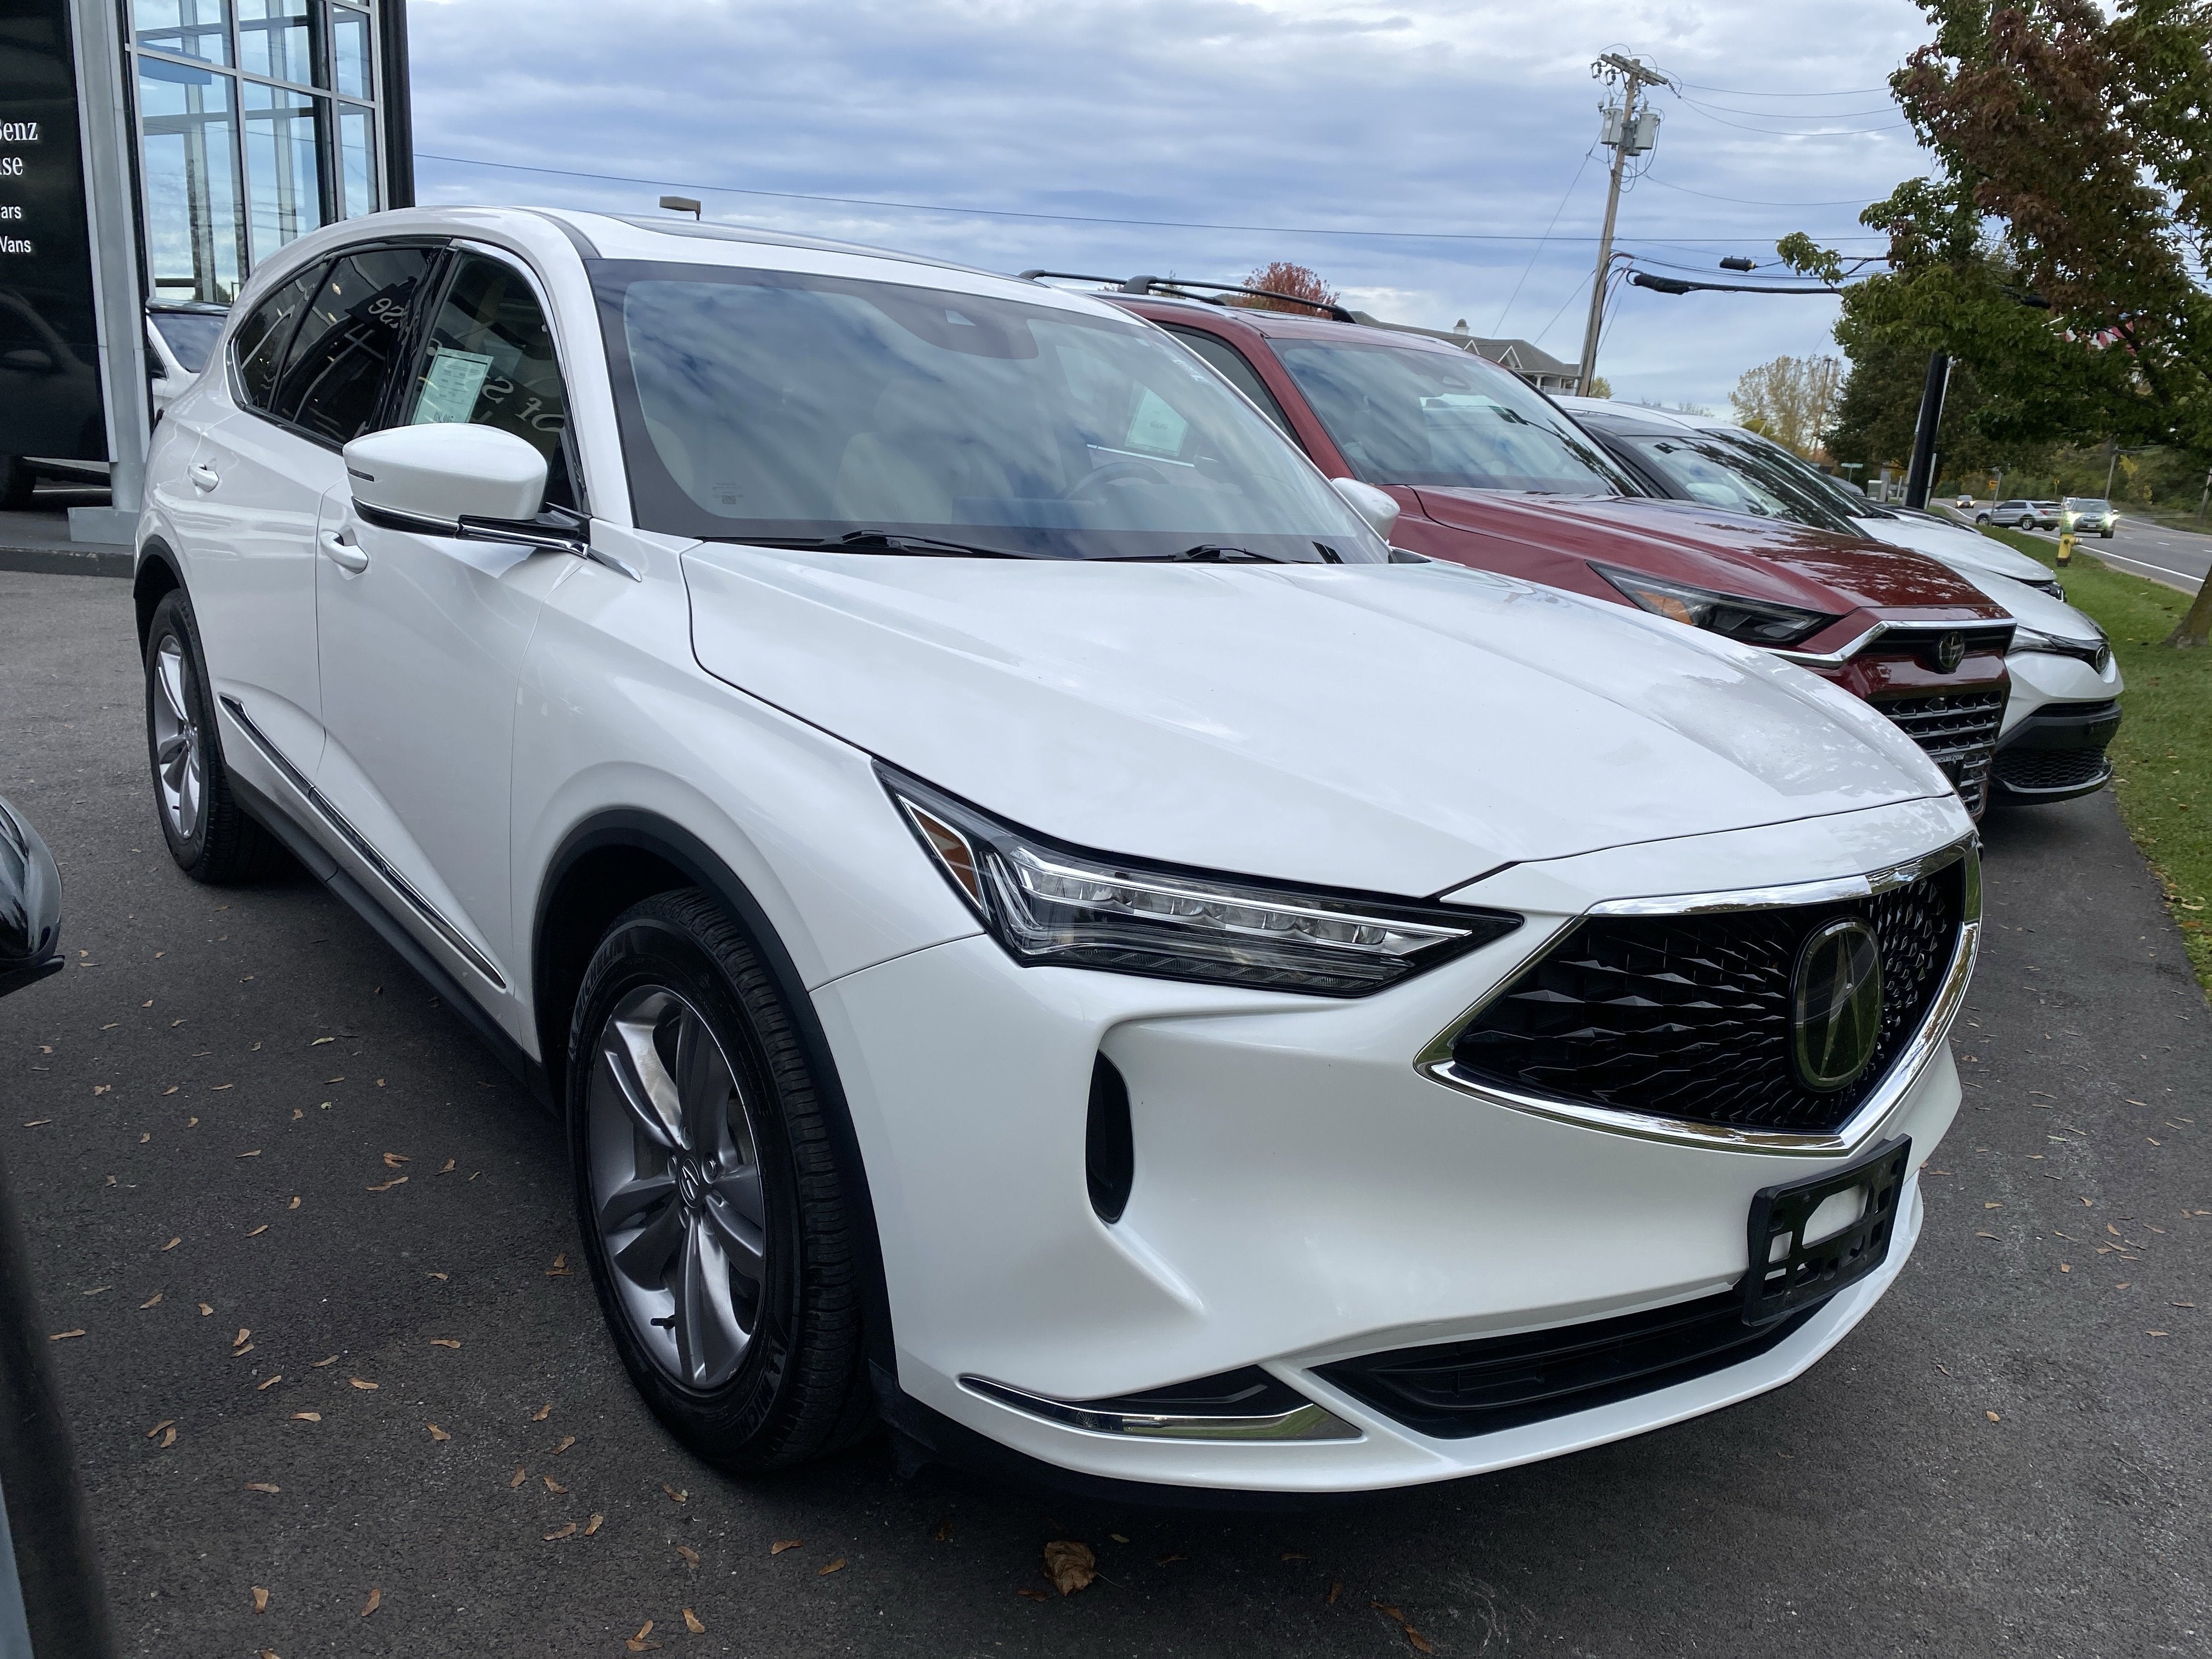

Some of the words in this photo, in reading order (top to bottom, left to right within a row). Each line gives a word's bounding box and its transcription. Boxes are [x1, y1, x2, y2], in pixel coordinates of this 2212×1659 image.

[0, 120, 38, 141] enz
[0, 157, 23, 176] se
[0, 206, 21, 219] ars
[0, 236, 31, 252] Vans
